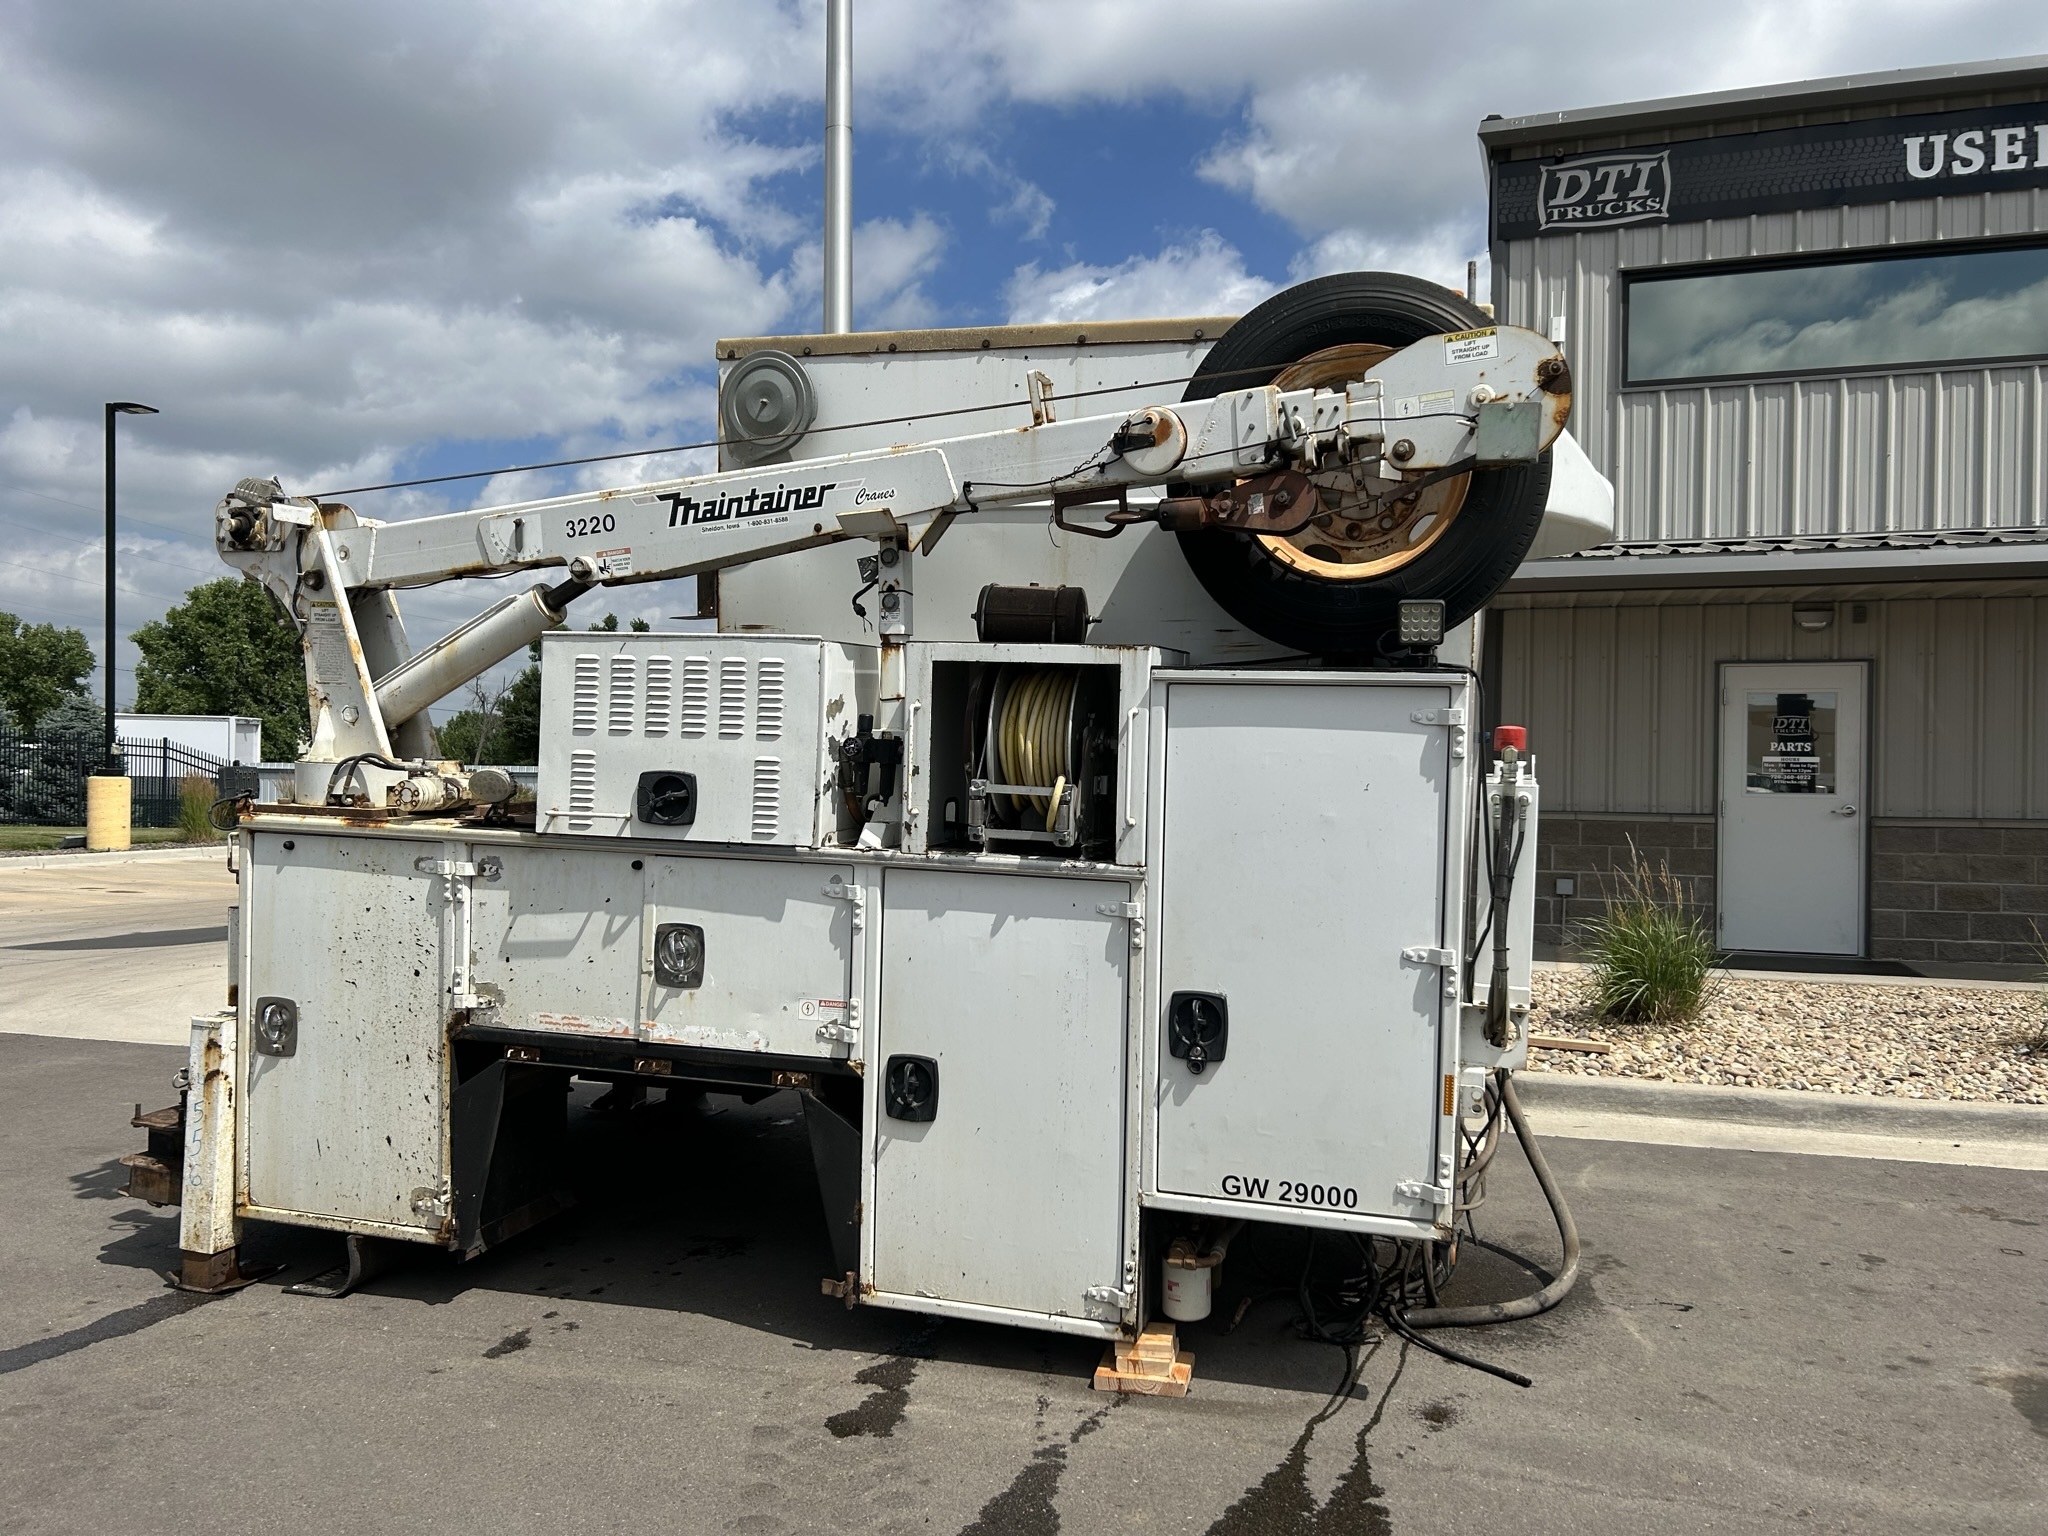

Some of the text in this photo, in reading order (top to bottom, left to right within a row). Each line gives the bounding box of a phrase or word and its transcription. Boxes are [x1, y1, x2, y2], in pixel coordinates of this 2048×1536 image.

[1547, 160, 1660, 207] DTI
[1547, 197, 1660, 221] TRUCKS
[1455, 330, 1487, 341] CAUTION
[1452, 346, 1480, 354] STRAIGHT
[855, 488, 895, 506] Cranes
[566, 514, 615, 538] 3220
[701, 525, 726, 533] Sheldon,
[1775, 718, 1807, 729] DTI
[1770, 742, 1811, 752] PARTS
[1221, 1175, 1358, 1208] GW 29000
